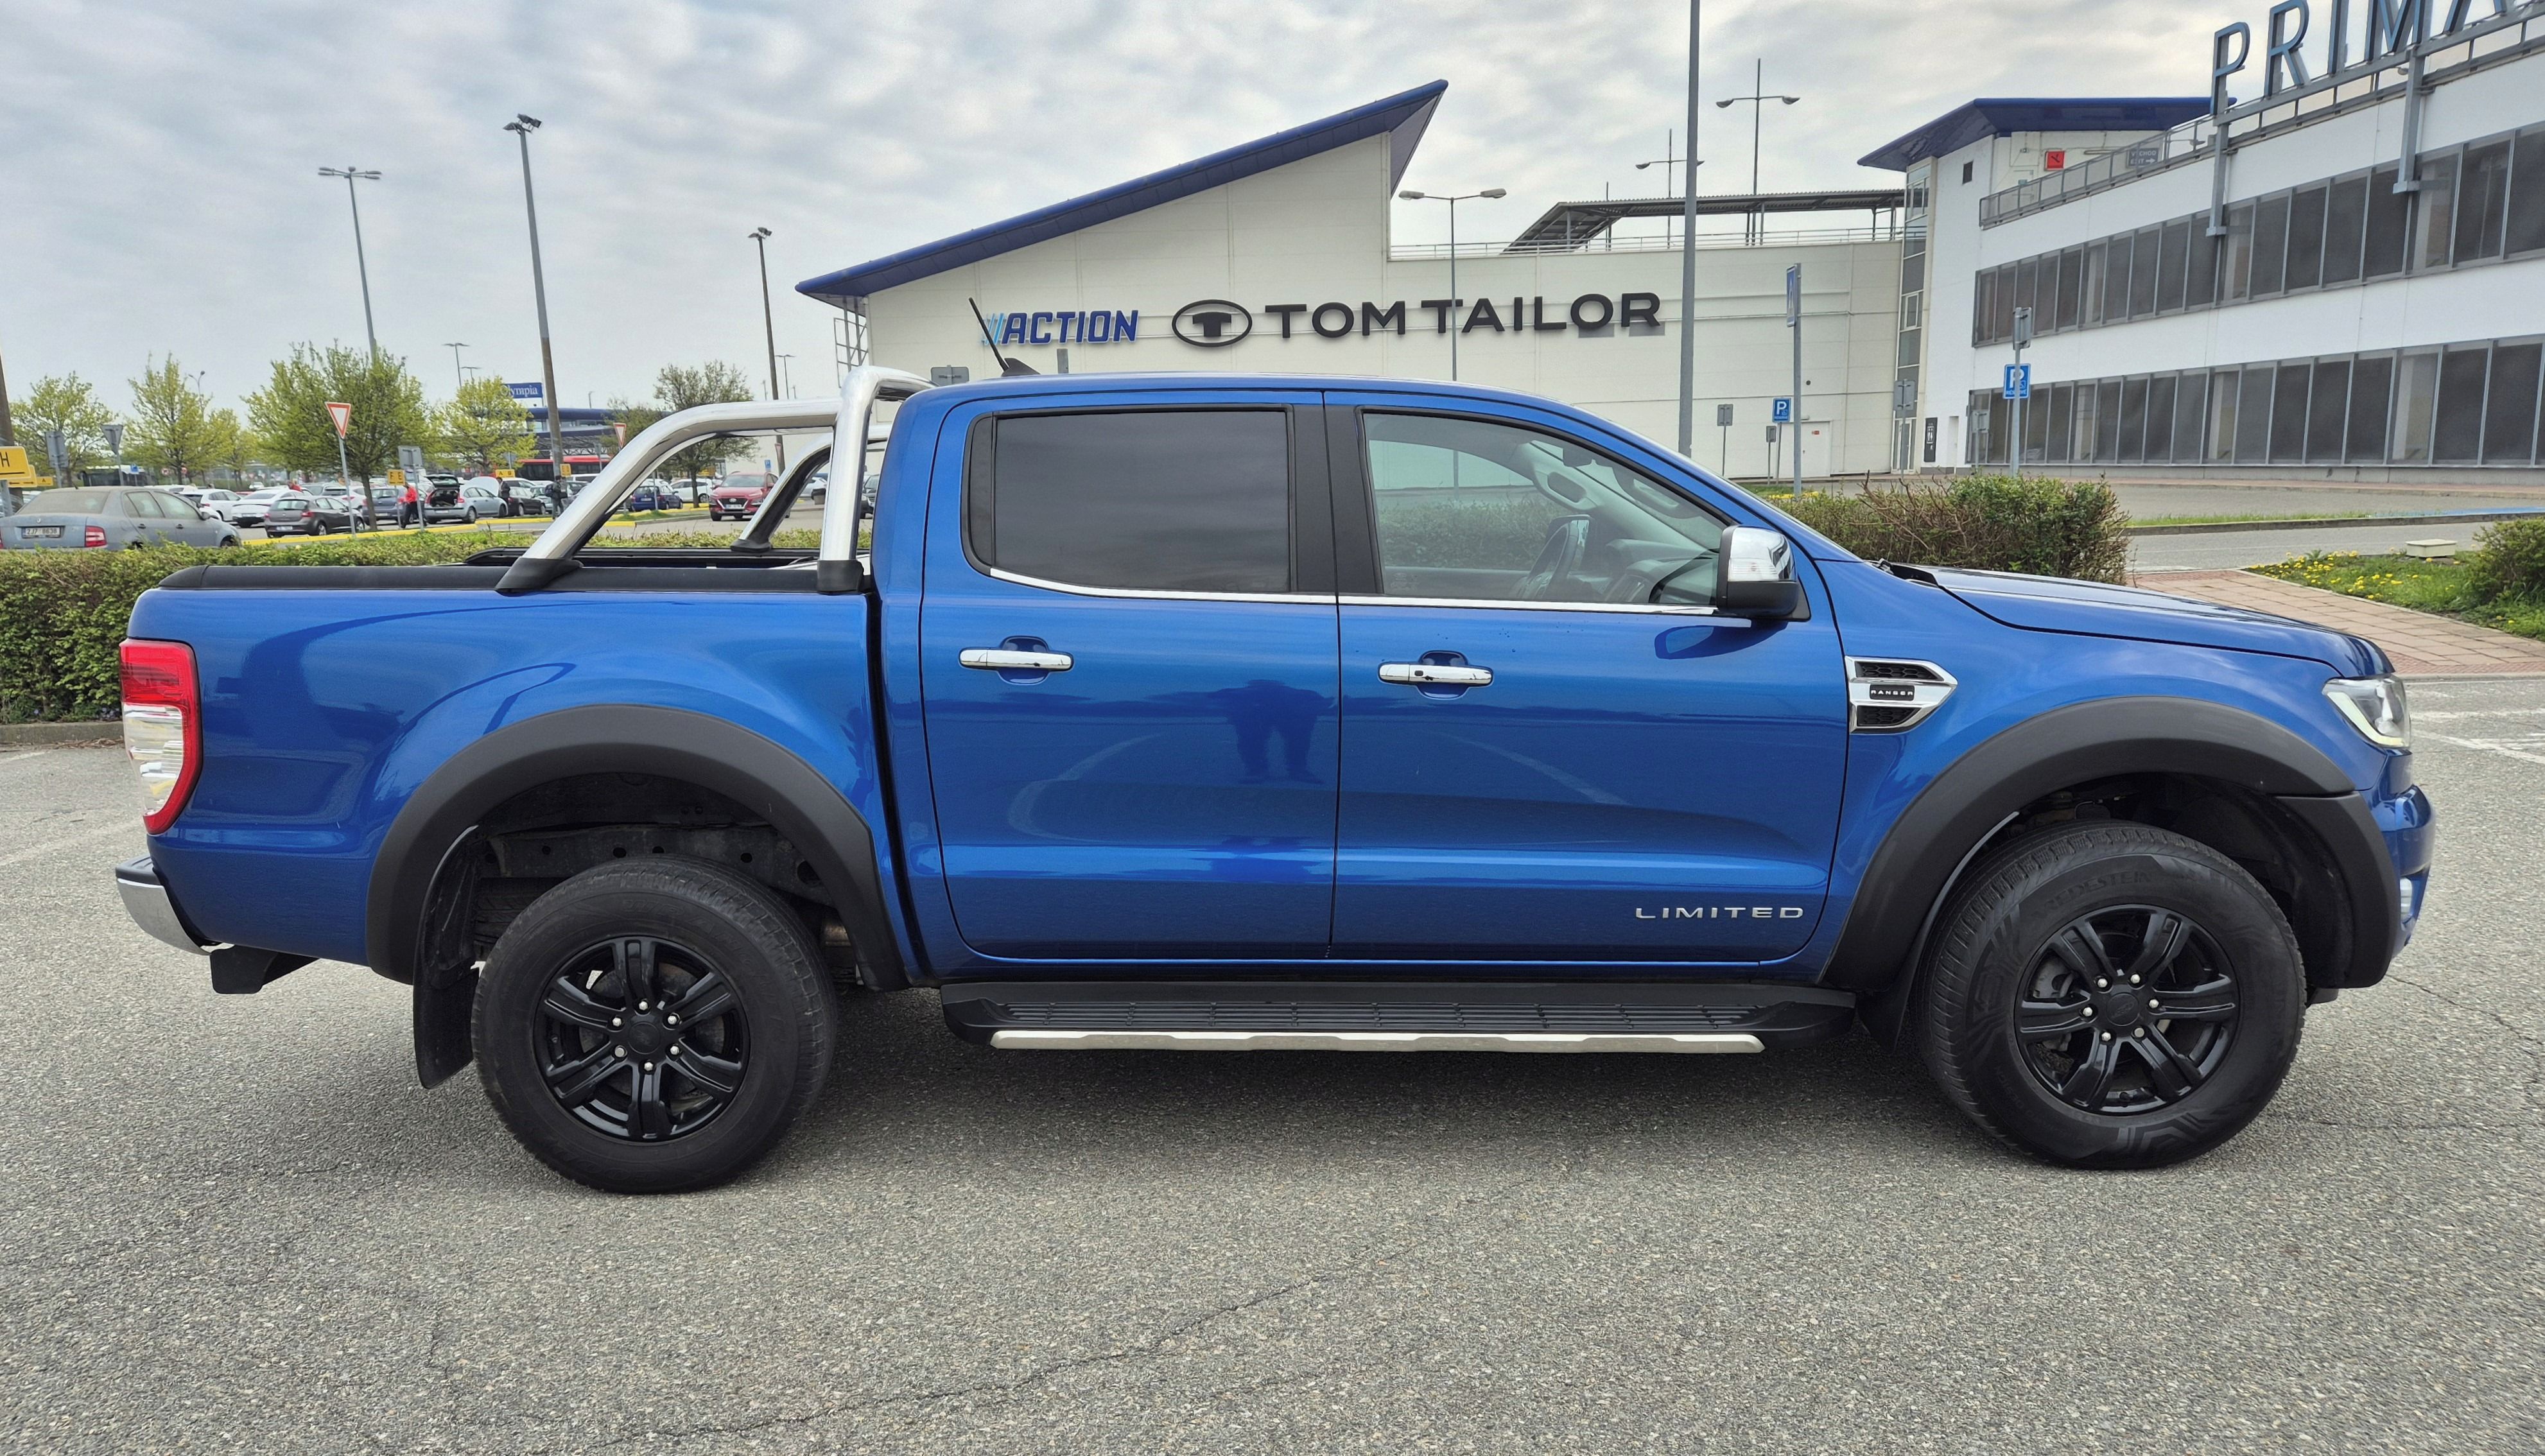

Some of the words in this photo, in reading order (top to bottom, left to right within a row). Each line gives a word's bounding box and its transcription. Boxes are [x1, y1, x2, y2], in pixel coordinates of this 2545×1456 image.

[1265, 300, 1406, 338] TOM
[1421, 291, 1661, 334] TAILOR
[1000, 310, 1139, 345] ACTION
[1776, 401, 1787, 415] P
[1635, 907, 1803, 919] LIMITED
